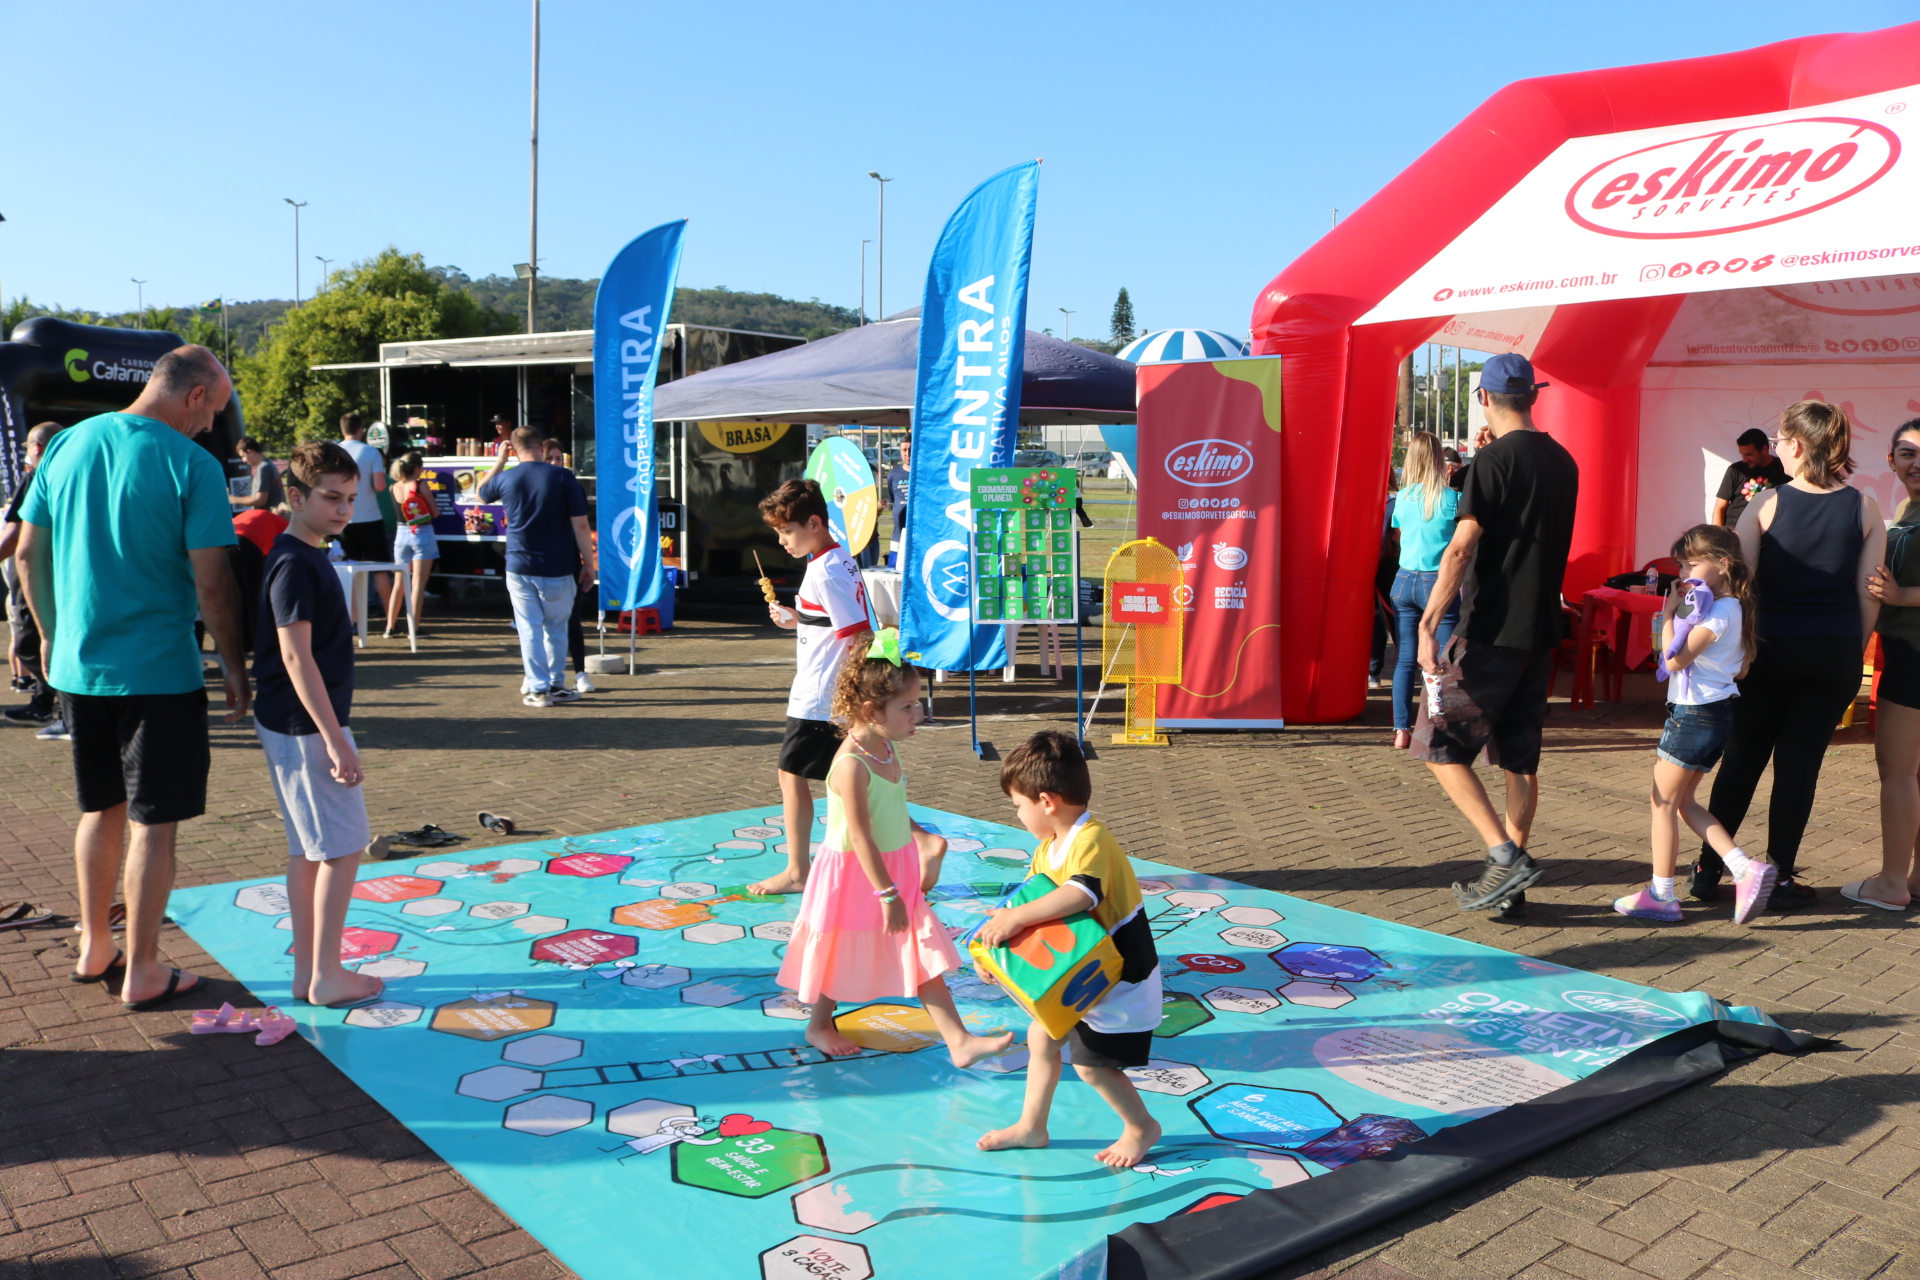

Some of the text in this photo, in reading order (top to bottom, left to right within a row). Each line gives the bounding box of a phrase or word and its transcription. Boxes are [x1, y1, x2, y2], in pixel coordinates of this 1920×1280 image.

[1631, 187, 1801, 220] SORVETES
[1458, 271, 1619, 298] www.eskimo.com.br
[997, 316, 1011, 379] AILOS
[92, 361, 152, 384] Catarine
[725, 425, 772, 447] BRASA
[1186, 470, 1232, 478] SORVETES
[977, 485, 1018, 494] ESKIMOVENDO
[987, 494, 1013, 502] PLANETA
[1161, 510, 1257, 520] @ESKIMOSORVETESOFICIAL
[1214, 586, 1247, 598] RECICLA
[1214, 598, 1245, 609] ESCOLA
[1315, 945, 1341, 954] 14
[1441, 1001, 1630, 1057] DE DESENVOLVI
[1457, 991, 1657, 1049] OBJETIV
[1420, 1007, 1618, 1068] SUSTENTA
[1144, 1071, 1186, 1088] CASAS
[1152, 1068, 1186, 1082] PULE
[1243, 1093, 1266, 1102] 6
[1226, 1099, 1309, 1130] ÁGUA POTÁVEL
[1228, 1107, 1303, 1139] SANEAMENTO
[735, 1137, 774, 1153] 33
[706, 1157, 760, 1187] BEM-ESTAR
[807, 1248, 849, 1274] VOLTE
